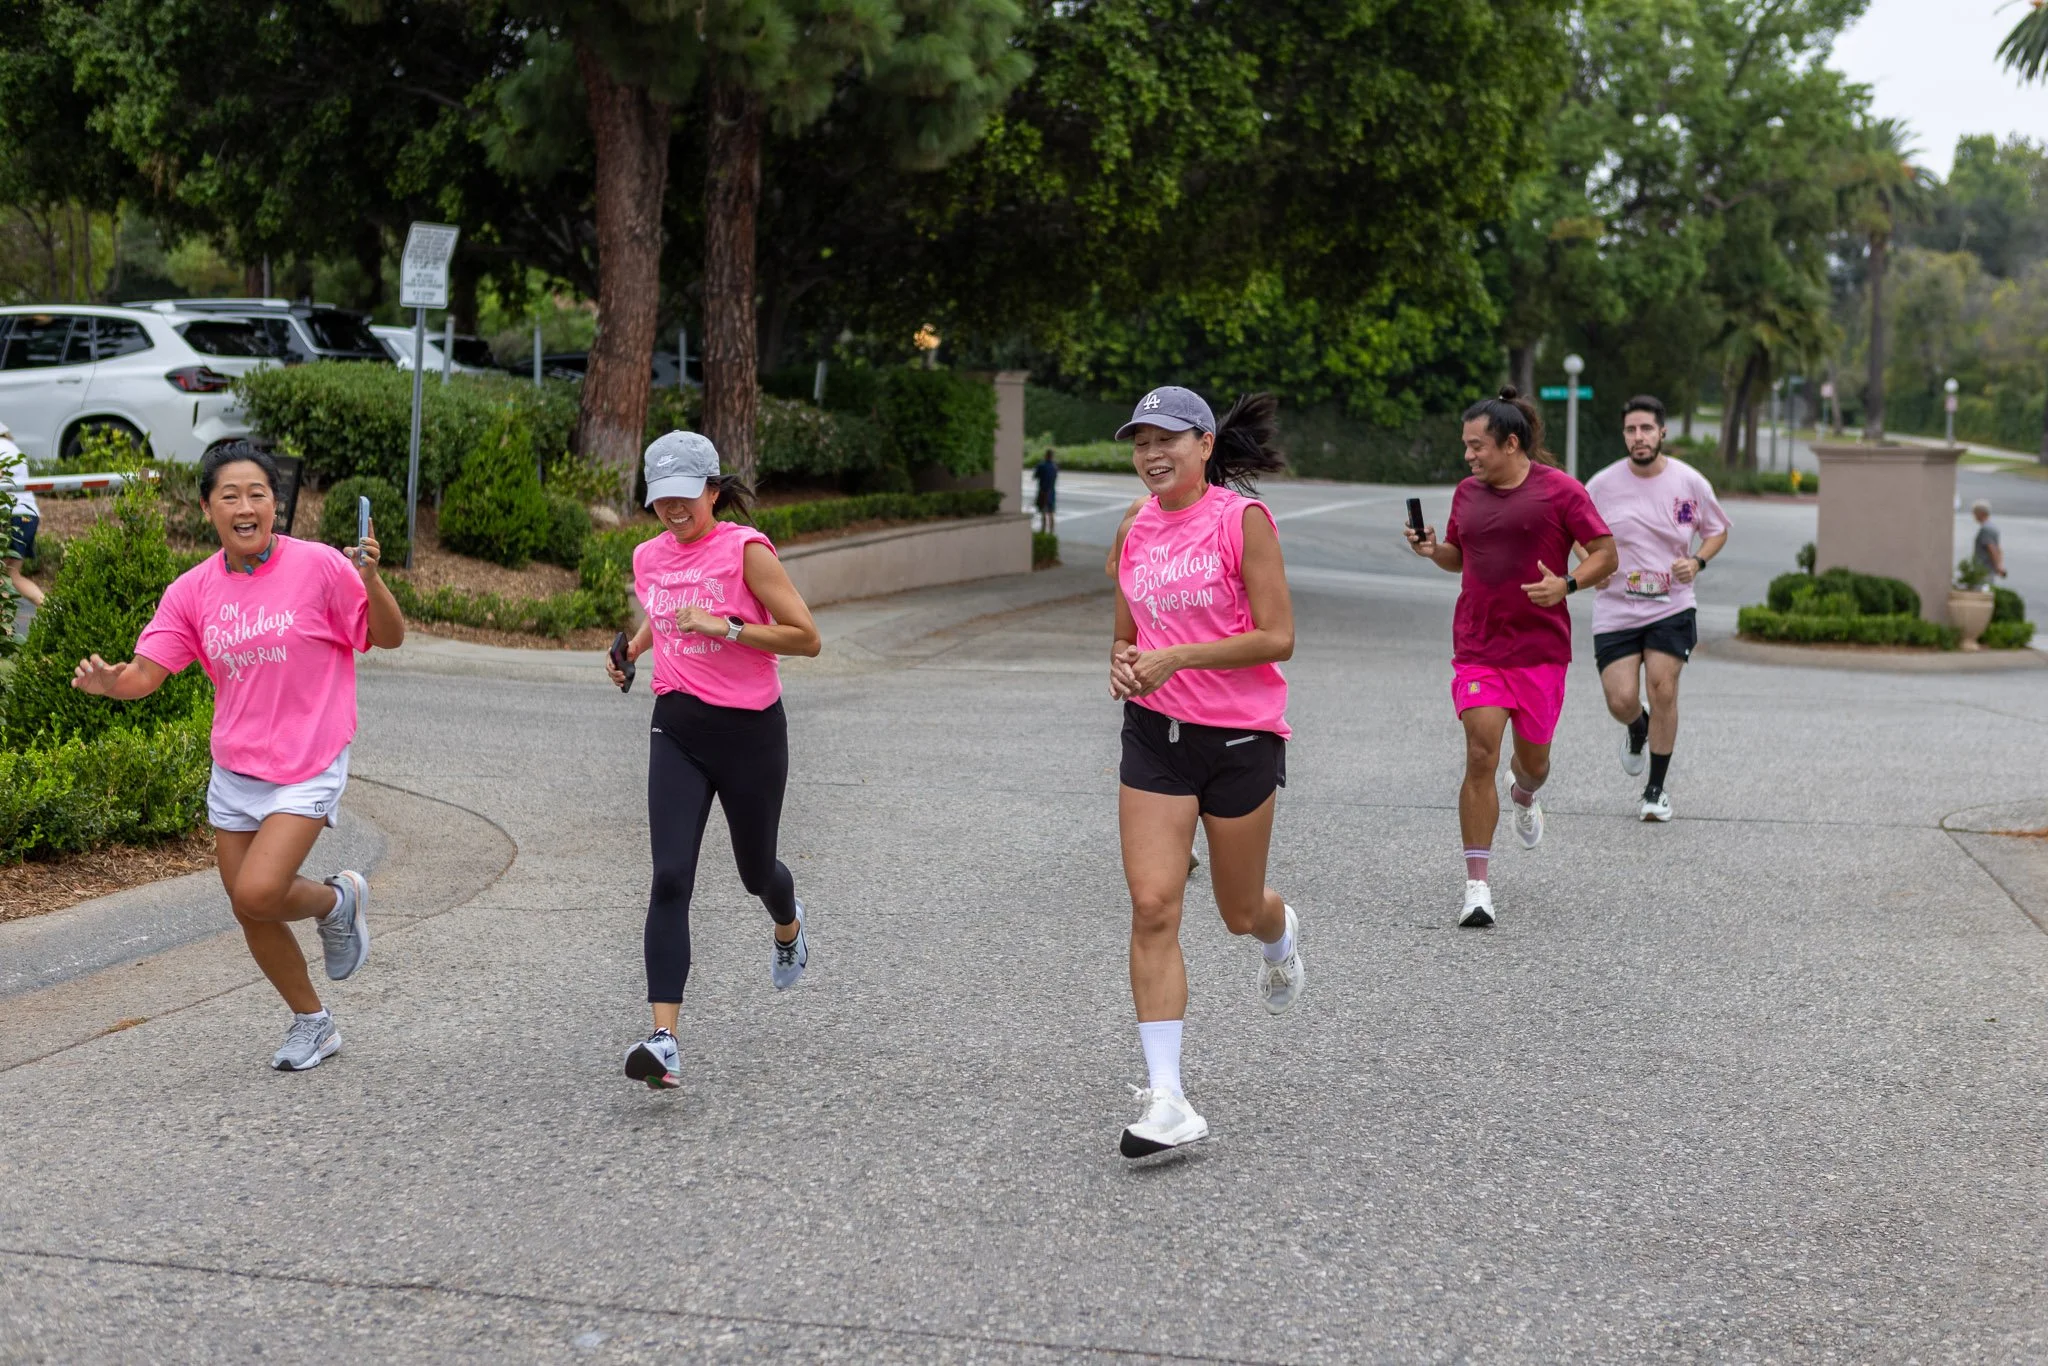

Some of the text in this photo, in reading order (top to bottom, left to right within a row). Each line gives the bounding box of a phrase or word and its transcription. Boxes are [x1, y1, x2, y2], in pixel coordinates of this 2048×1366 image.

[1143, 392, 1161, 410] LA
[1150, 543, 1170, 563] ON
[682, 568, 702, 583] MY
[1133, 546, 1220, 602] Birthdays
[1180, 587, 1213, 611] RUN
[220, 601, 240, 621] ON
[203, 605, 296, 660] Birthdays
[257, 645, 287, 665] RUN
[673, 638, 683, 657] I
[682, 641, 708, 655] want
[710, 640, 722, 653] to
